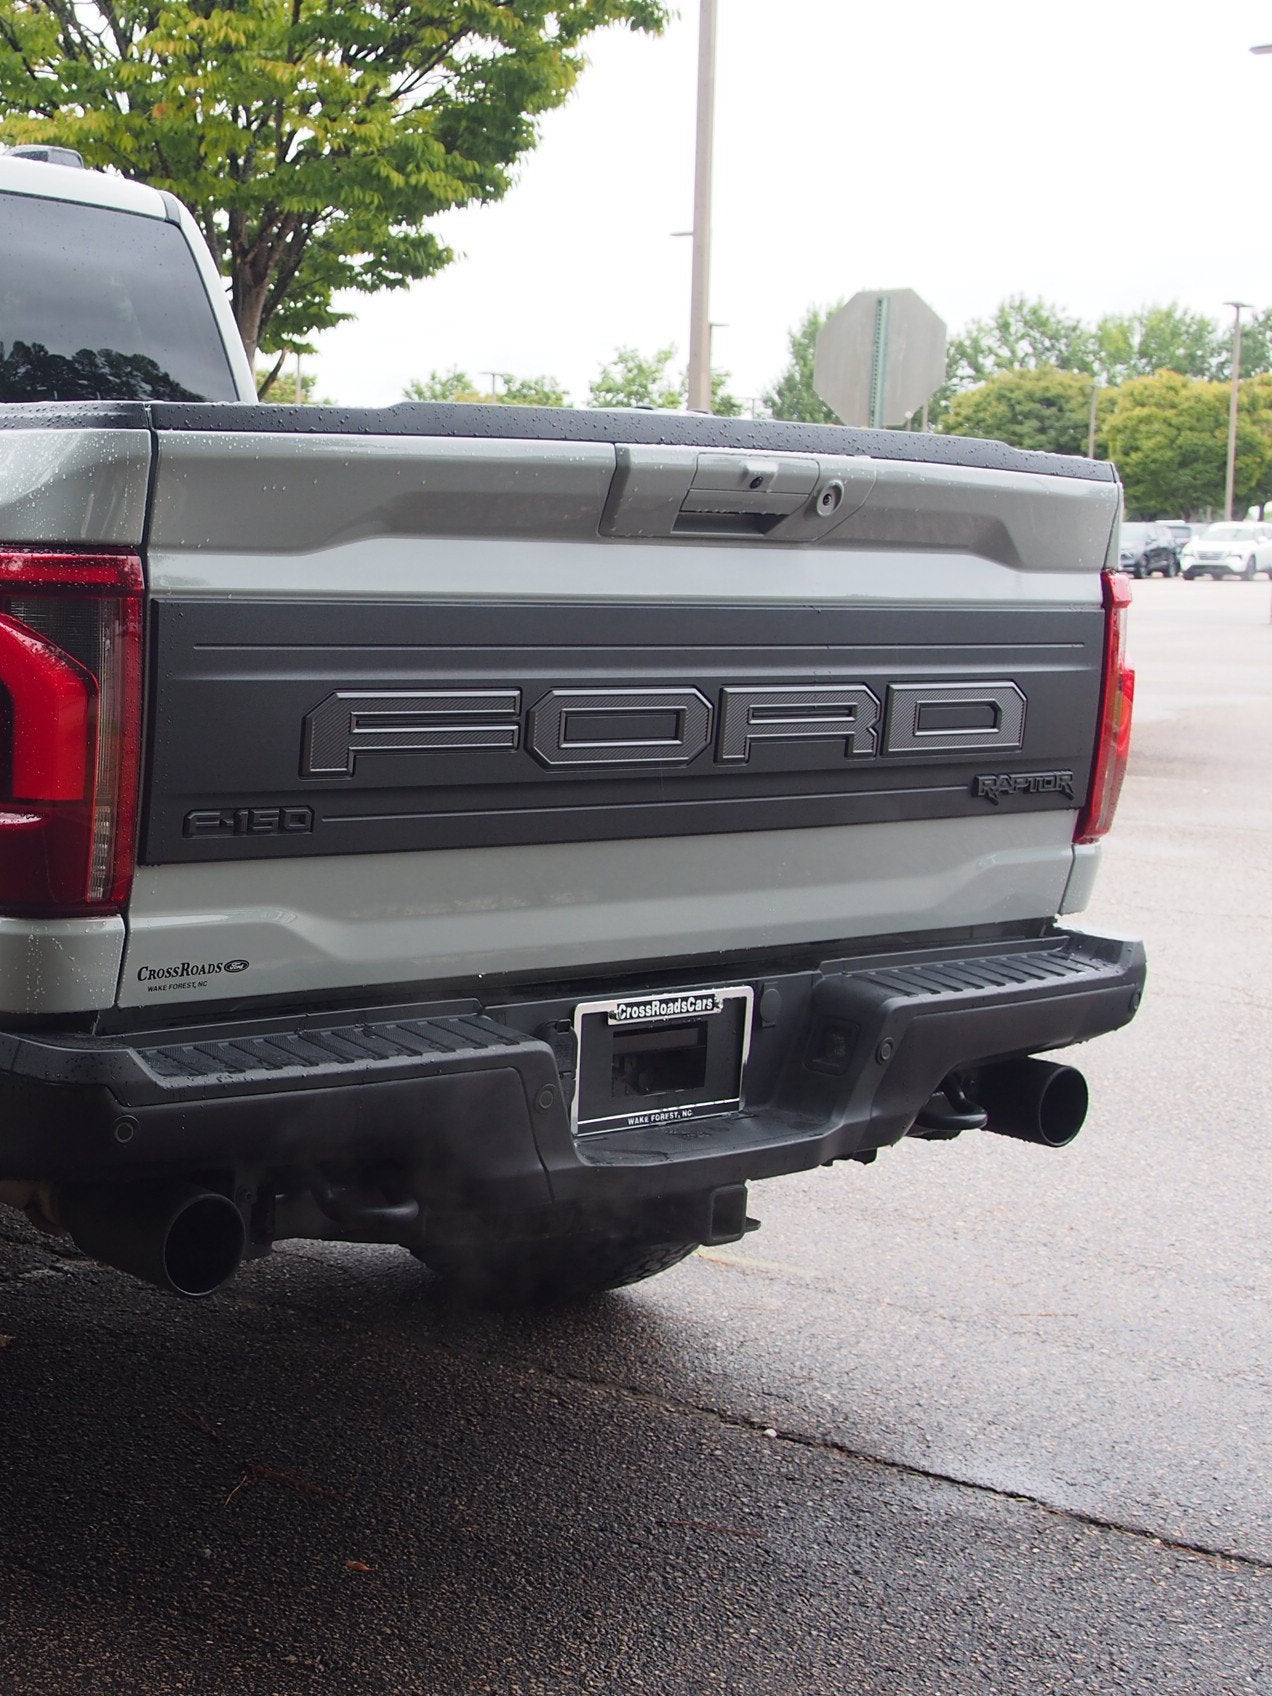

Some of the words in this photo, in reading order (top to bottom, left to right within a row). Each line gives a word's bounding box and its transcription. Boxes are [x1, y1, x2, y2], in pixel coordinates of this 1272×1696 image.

[299, 679, 1028, 780] FORD
[973, 768, 1074, 805] RAPTOR
[183, 805, 315, 839] F-150
[147, 984, 167, 993] WAKE
[168, 982, 196, 990] FOREST,
[198, 980, 208, 988] NC
[618, 997, 714, 1020] CrossRoadsCars
[628, 1113, 649, 1125] WAKE
